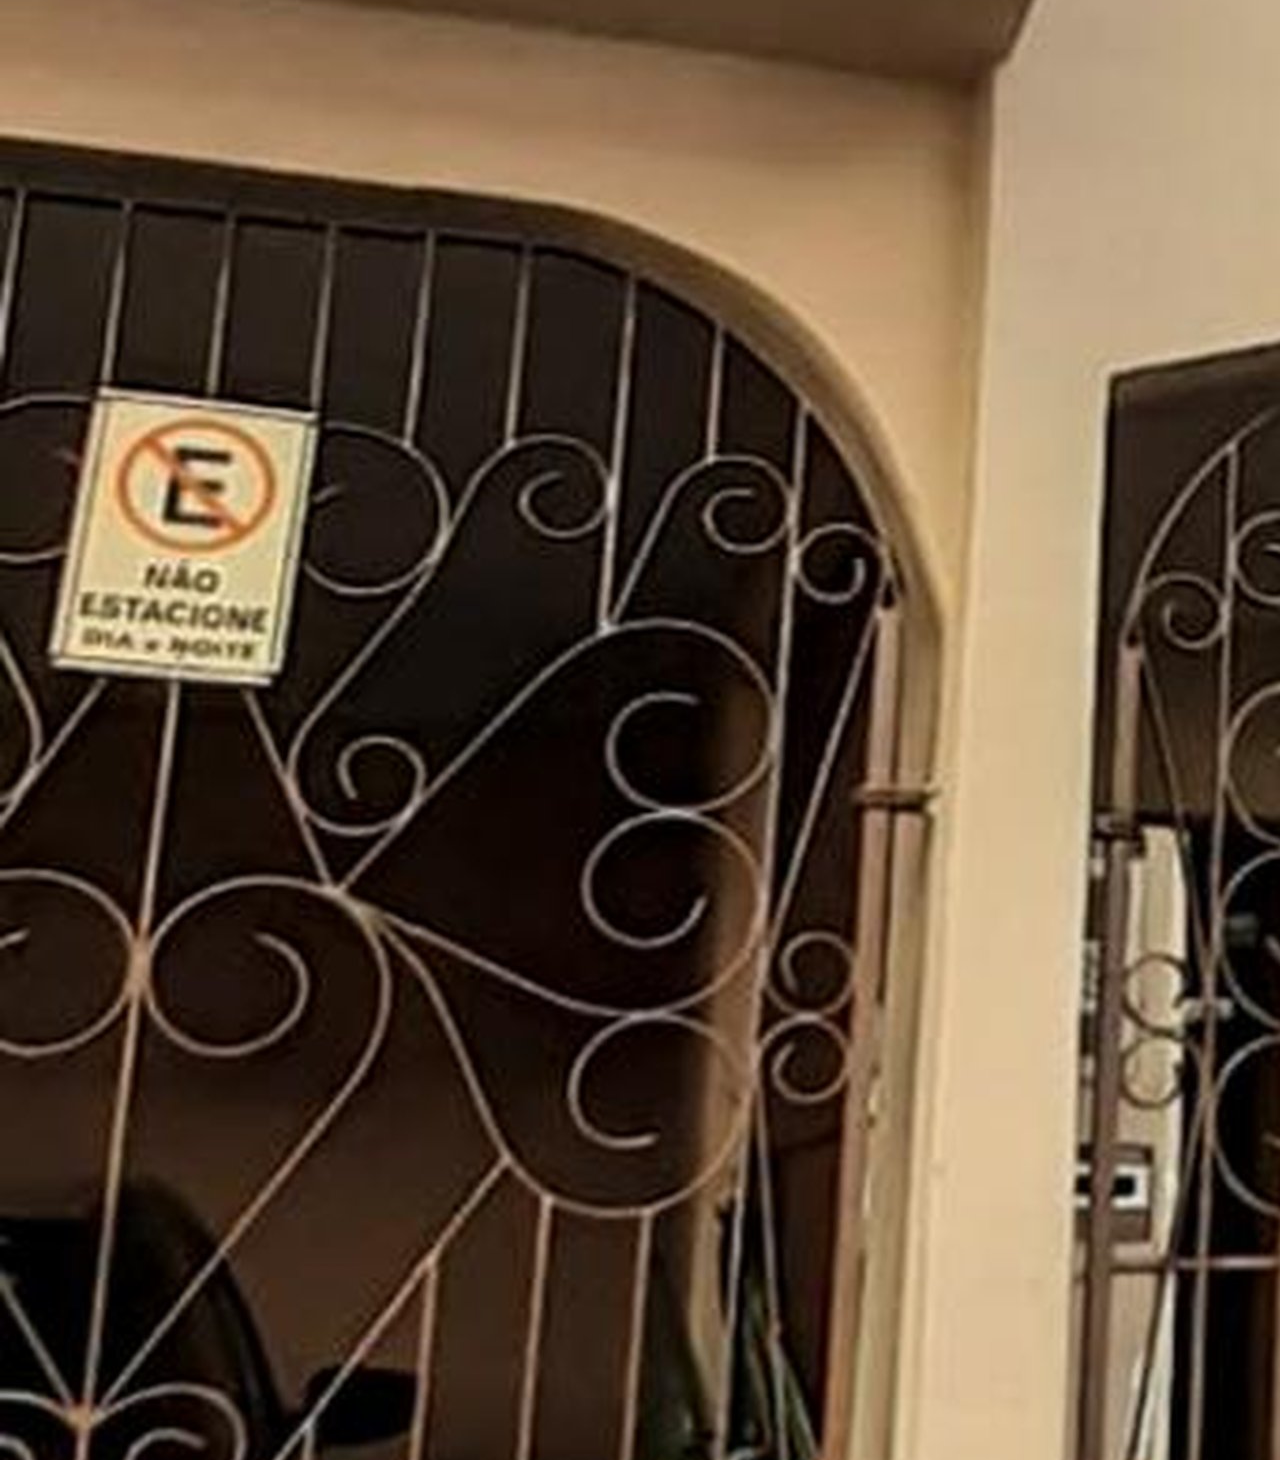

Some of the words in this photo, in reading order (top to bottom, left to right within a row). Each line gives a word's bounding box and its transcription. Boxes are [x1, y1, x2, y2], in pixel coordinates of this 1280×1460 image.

[162, 446, 232, 529] E
[143, 560, 221, 594] NÃO
[79, 591, 269, 633] ESTACIONE
